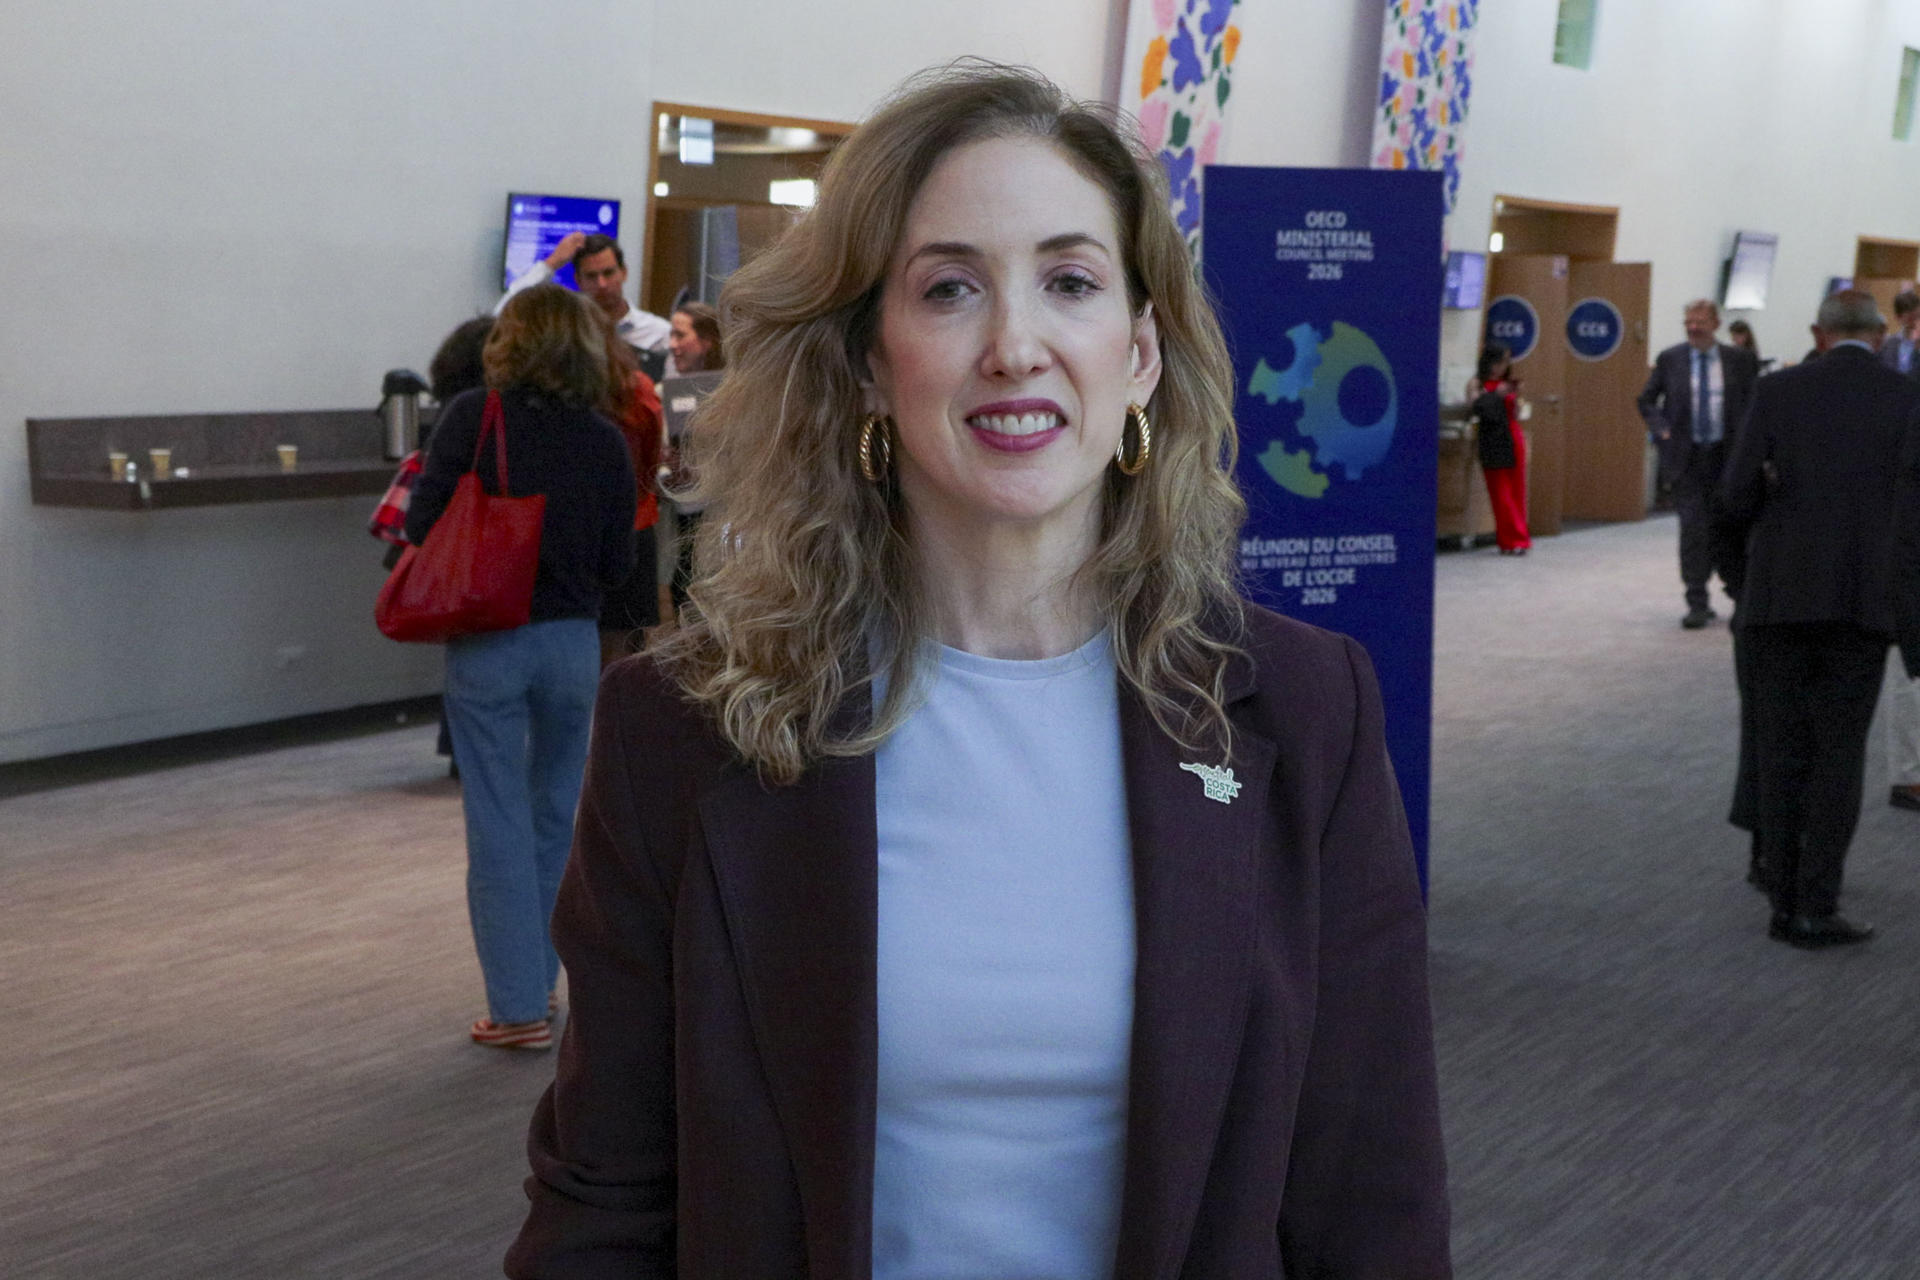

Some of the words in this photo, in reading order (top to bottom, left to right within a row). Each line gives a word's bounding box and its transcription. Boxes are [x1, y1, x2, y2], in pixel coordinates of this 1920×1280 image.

[1305, 211, 1347, 229] OECD
[1276, 230, 1374, 248] MINISTERIAL
[1276, 248, 1323, 261] COUNCIL
[1326, 248, 1374, 261] MEETING
[1307, 263, 1343, 280] 2026
[1241, 536, 1310, 557] RÉUNION
[1312, 537, 1336, 553] DU
[1336, 533, 1397, 552] CONSEIL
[1260, 556, 1308, 569] NIVEAU
[1309, 554, 1332, 567] DES
[1333, 551, 1397, 566] MINISTRES
[1282, 570, 1303, 587] DE
[1305, 567, 1356, 586] L'OCDE
[1301, 586, 1338, 605] 2026
[1206, 778, 1236, 795] COSTA
[1207, 786, 1228, 800] RICA
